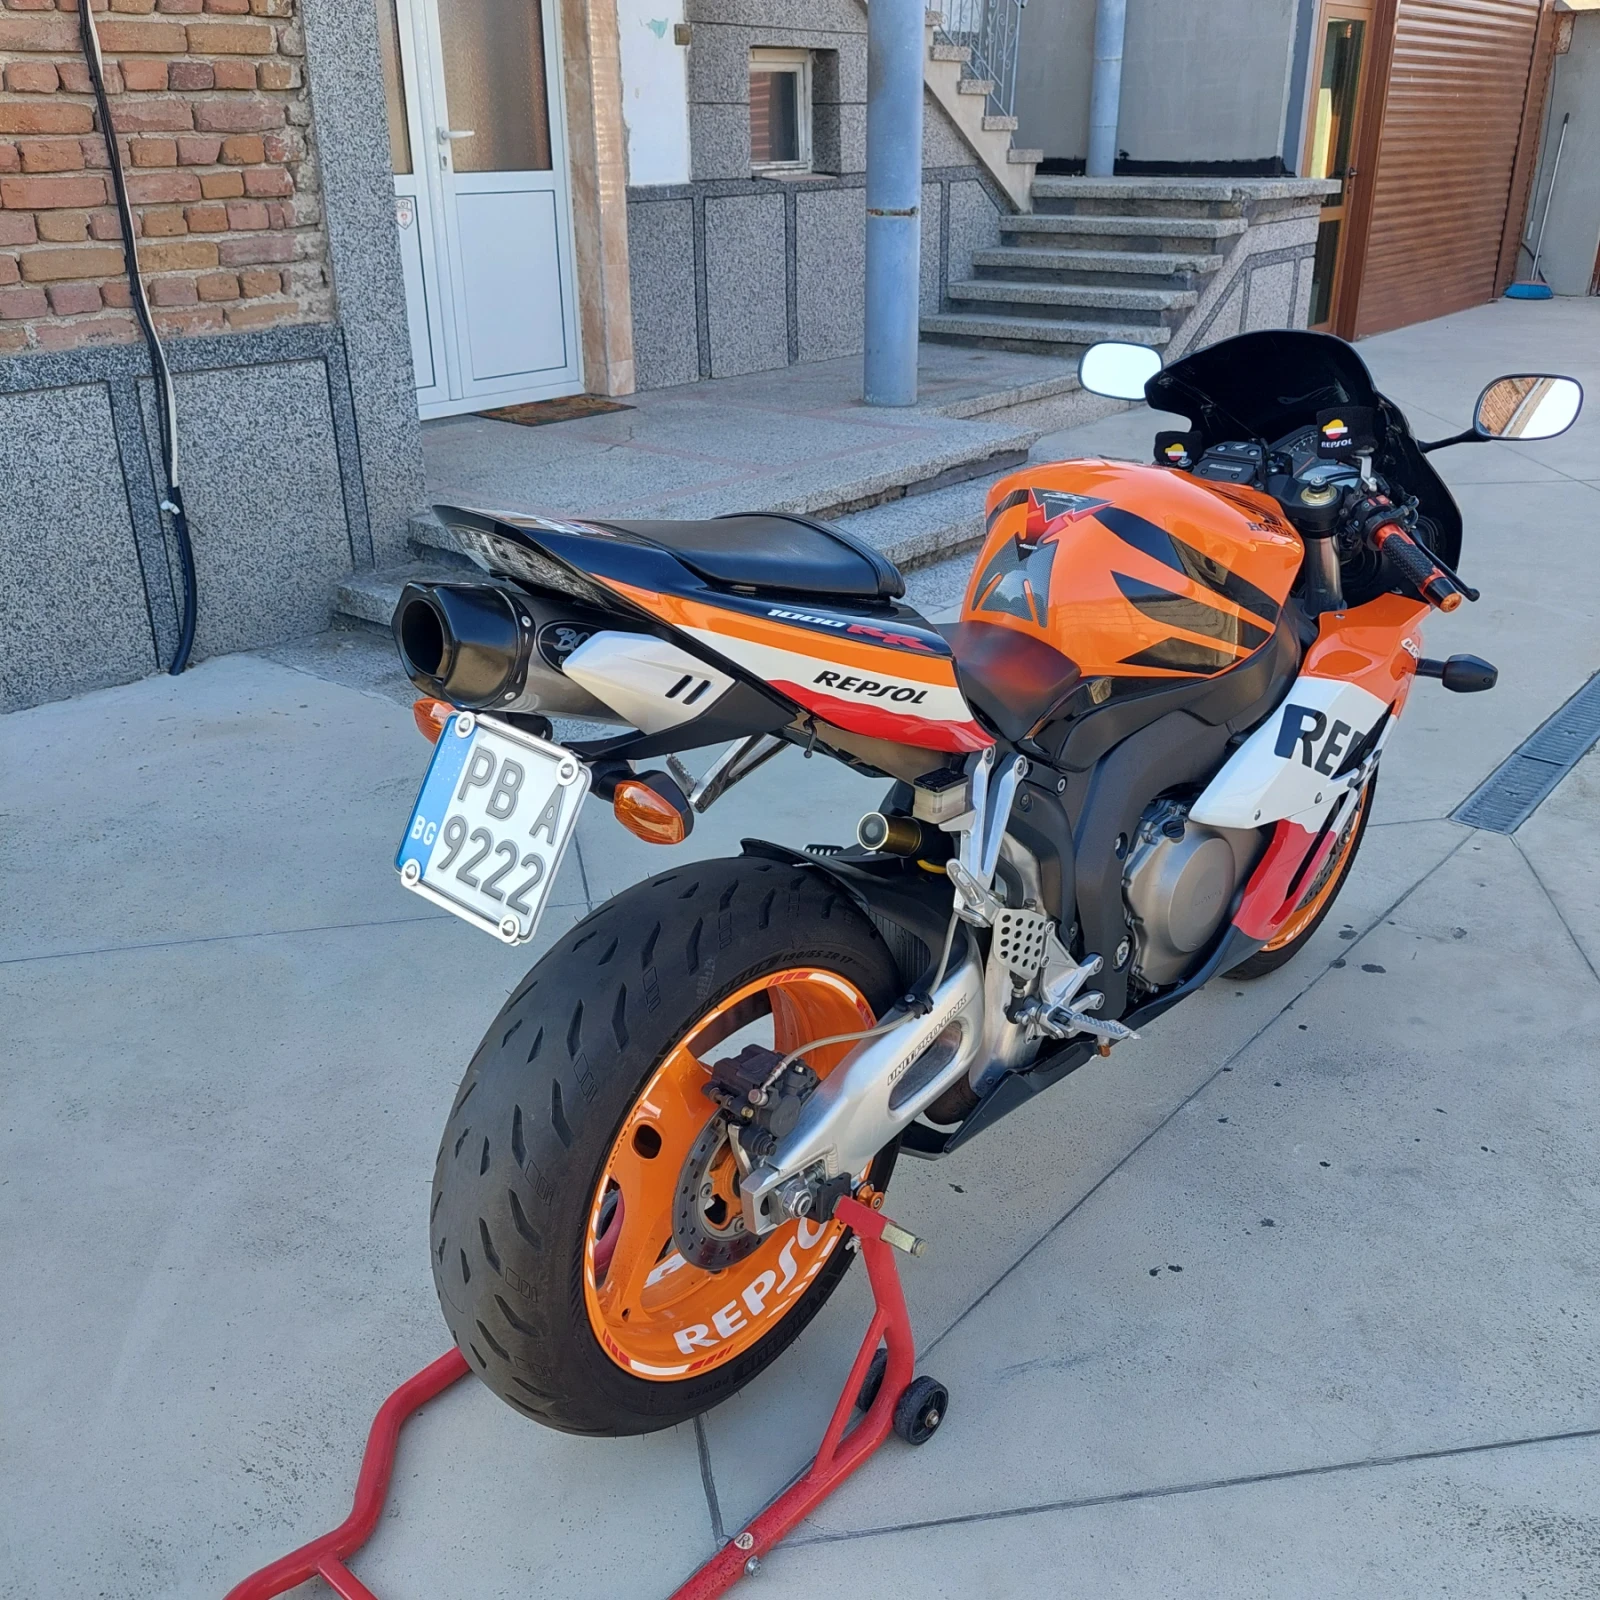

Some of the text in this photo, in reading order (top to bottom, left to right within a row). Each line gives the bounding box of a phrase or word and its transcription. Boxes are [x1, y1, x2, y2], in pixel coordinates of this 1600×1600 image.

[1321, 438, 1352, 449] REPSOL
[1245, 521, 1296, 539] HONDA
[767, 609, 935, 651] 1000 RR
[813, 670, 928, 704] REPSOL
[457, 746, 566, 846] PB A
[410, 815, 437, 846] BG
[437, 814, 546, 916] 9222
[783, 950, 824, 962] 190/55
[673, 1217, 828, 1354] REPSO
